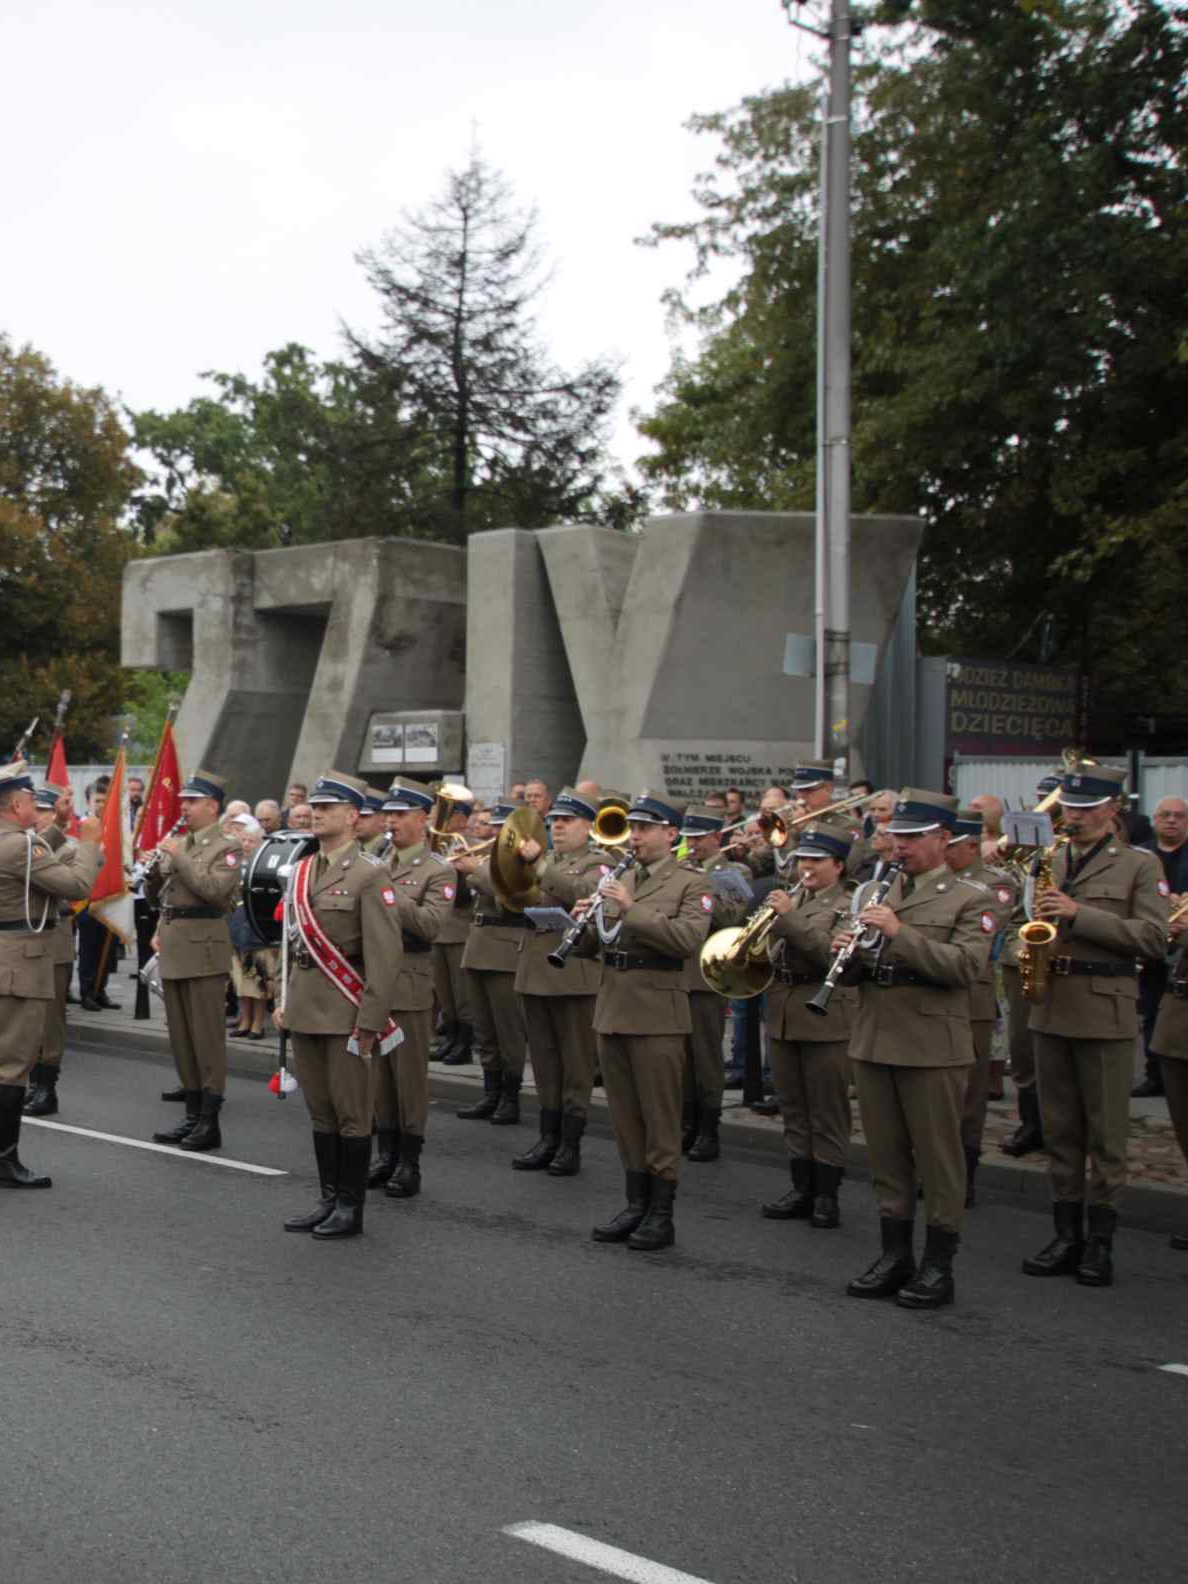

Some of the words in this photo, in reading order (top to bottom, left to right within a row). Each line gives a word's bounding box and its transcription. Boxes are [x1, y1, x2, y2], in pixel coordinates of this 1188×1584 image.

[951, 711, 1073, 740] DZIECIĘCA
[677, 754, 700, 762] TYM
[705, 754, 751, 763] MIEJSCU
[729, 767, 773, 775] WOJSKA
[665, 777, 693, 786] ORAZ
